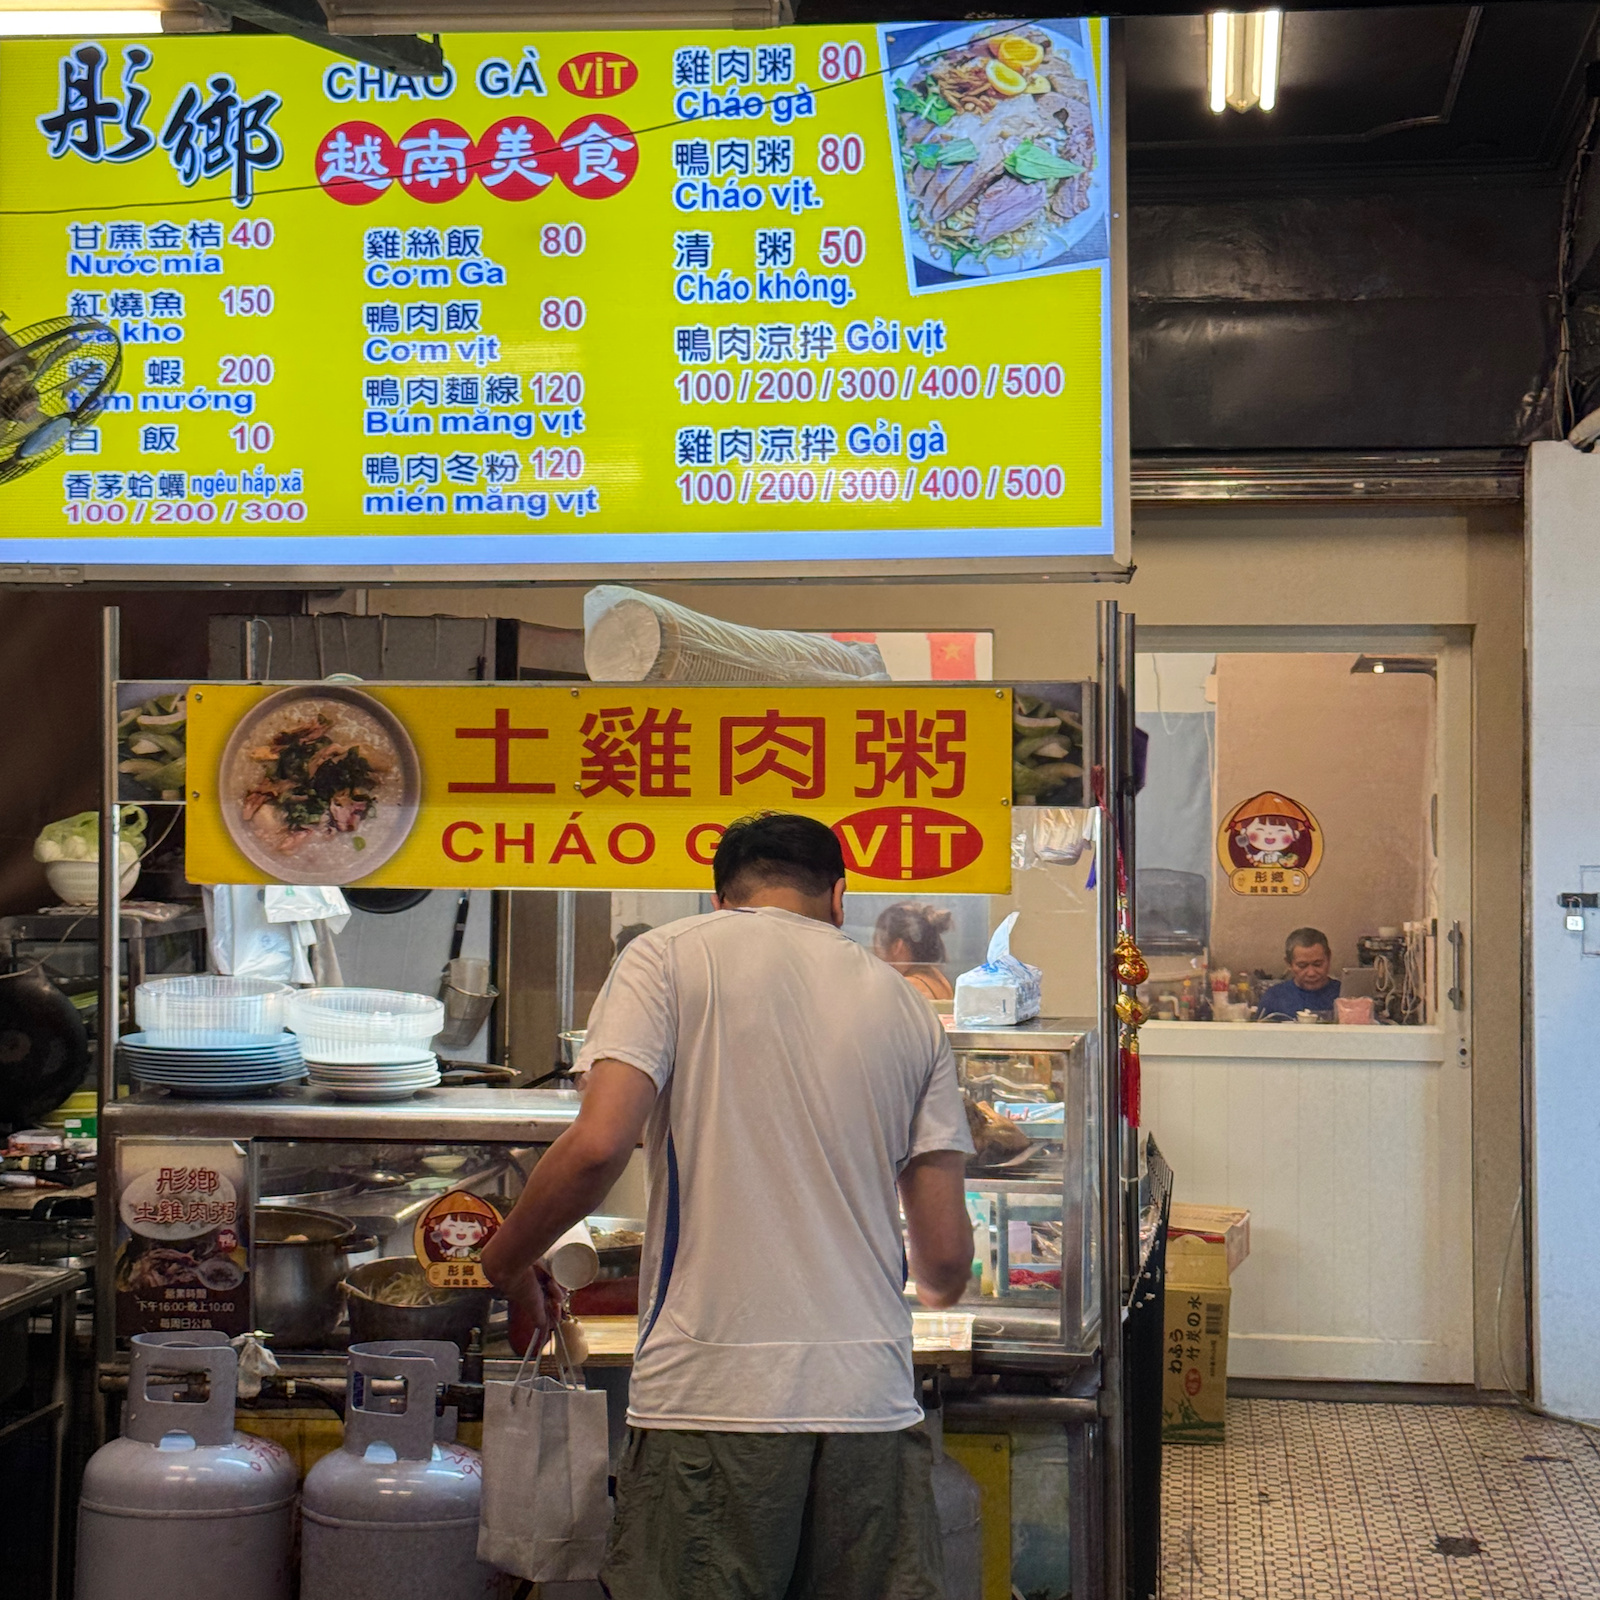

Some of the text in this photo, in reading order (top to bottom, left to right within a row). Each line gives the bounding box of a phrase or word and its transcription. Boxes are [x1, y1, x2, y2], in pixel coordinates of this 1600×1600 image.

[479, 47, 545, 96] GÀ
[675, 45, 863, 85] 雞肉粥 80
[676, 86, 813, 123] Cháo gà
[319, 121, 635, 190] 越南美食
[675, 137, 862, 176] 鴨肉粥 80
[675, 179, 821, 213] Cháo vịt.
[70, 222, 271, 249] 甘蔗金桔 40
[366, 225, 583, 259] 雞絲飯 80
[822, 229, 863, 264] 50
[71, 253, 222, 274] Nước mía
[459, 260, 504, 285] Gà
[70, 288, 271, 317] 紅燒魚 150
[676, 270, 854, 306] Cháo không.
[124, 322, 182, 342] kho
[366, 300, 583, 333] 鴨肉飯 80
[457, 337, 499, 365] vịt
[676, 325, 834, 362] 鴨肉涼拌
[906, 322, 944, 354] vịt
[222, 358, 271, 384] 200
[142, 387, 254, 413] nướng
[366, 374, 582, 406] 鴨肉麵線 120
[232, 425, 271, 450] 10
[366, 408, 584, 437] Bún măng vịt
[677, 427, 837, 465] 雞肉涼拌
[909, 423, 945, 460] gà
[366, 449, 582, 484] 鴨肉冬粉 120
[192, 472, 237, 497] ngêu
[456, 488, 547, 517] măng
[556, 488, 598, 516] vịt
[448, 706, 967, 801] 土雞肉粥
[442, 811, 656, 865] CHÁO
[133, 1200, 237, 1224] 土雞肉粥
[1185, 1294, 1203, 1362] 竹炭の水
